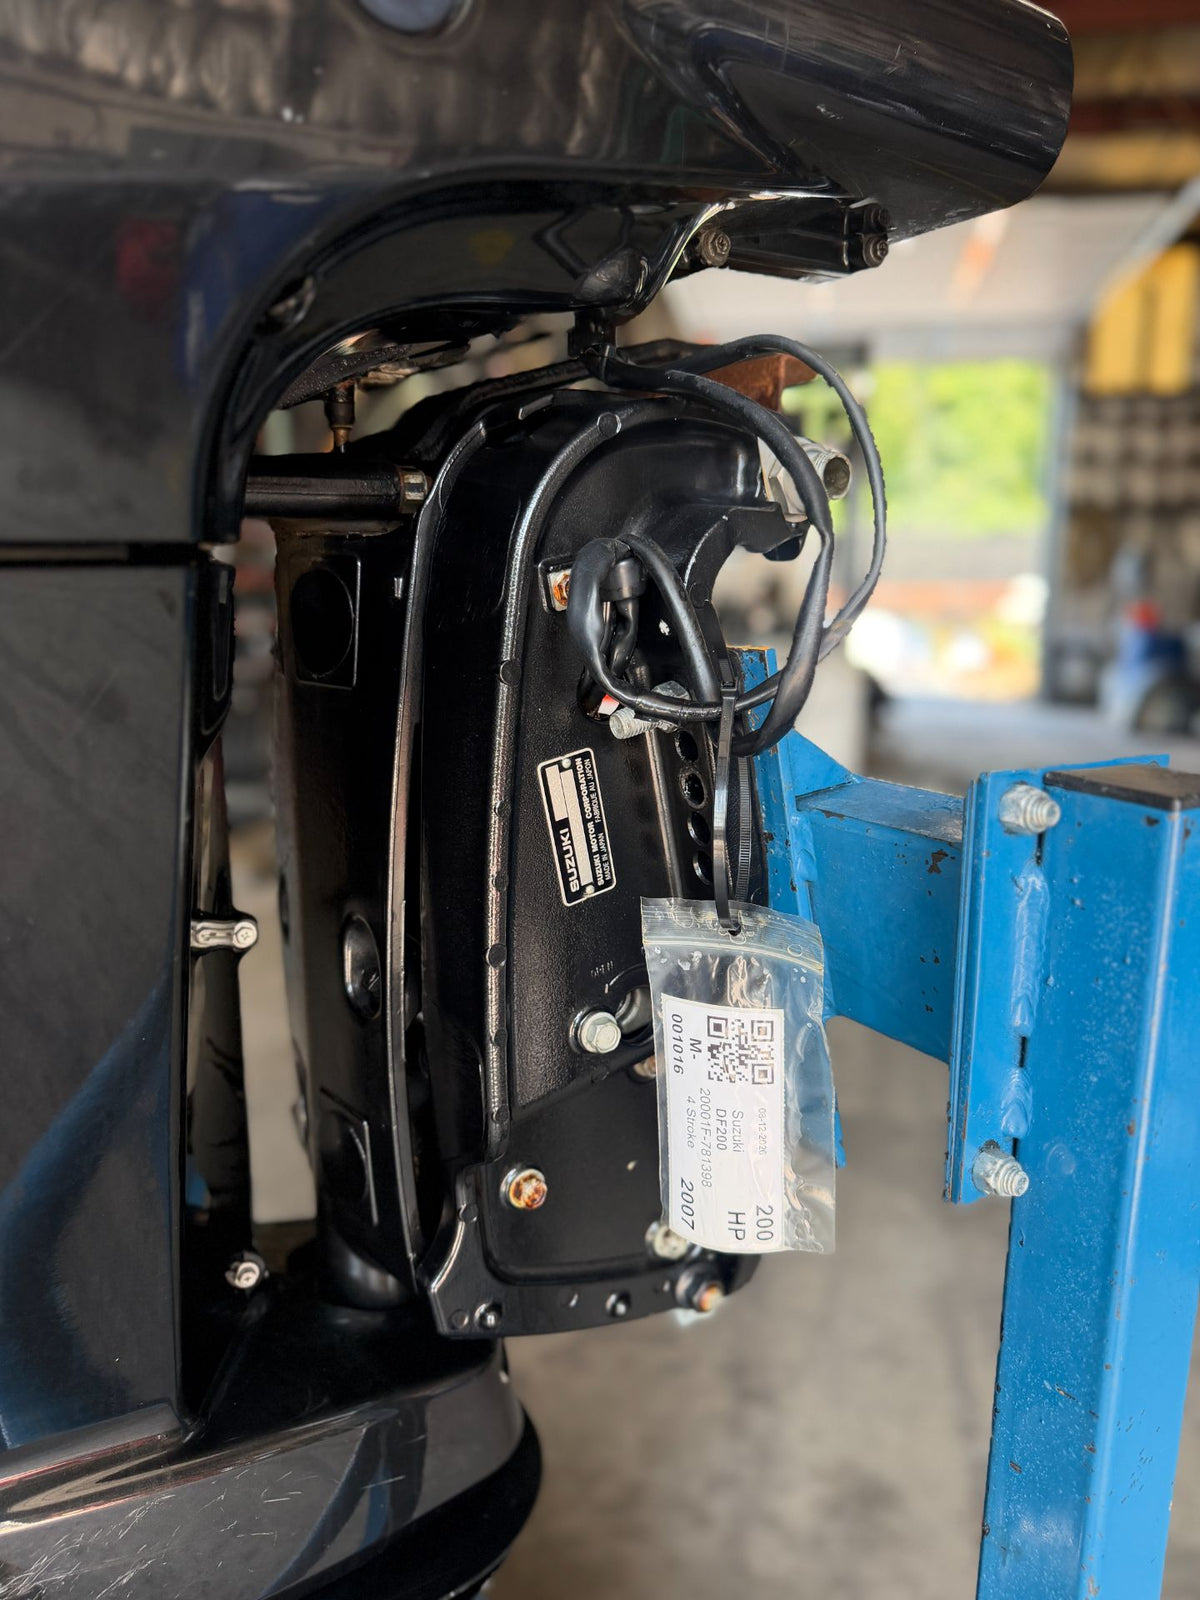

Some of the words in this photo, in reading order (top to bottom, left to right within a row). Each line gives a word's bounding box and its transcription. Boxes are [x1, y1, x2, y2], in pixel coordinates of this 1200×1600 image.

[584, 759, 593, 779] JAPON
[575, 758, 592, 819] CORPORATION
[588, 780, 596, 792] AU
[588, 822, 598, 852] MOTOR
[598, 832, 606, 852] JAPAN
[560, 828, 580, 892] SUZUKI
[593, 854, 604, 886] SUZUKI
[601, 854, 608, 862] IN
[602, 861, 610, 881] MADE
[672, 1014, 684, 1074] 001016
[689, 1038, 702, 1060] M-
[687, 1096, 695, 1105] 4
[687, 1108, 697, 1148] Stroke
[700, 1088, 712, 1188] 20001F-781398
[716, 1109, 726, 1150] DF200
[732, 1111, 744, 1152] Suzuki
[680, 1177, 694, 1230] 2007
[728, 1210, 746, 1240] HP
[756, 1205, 774, 1241] 200
